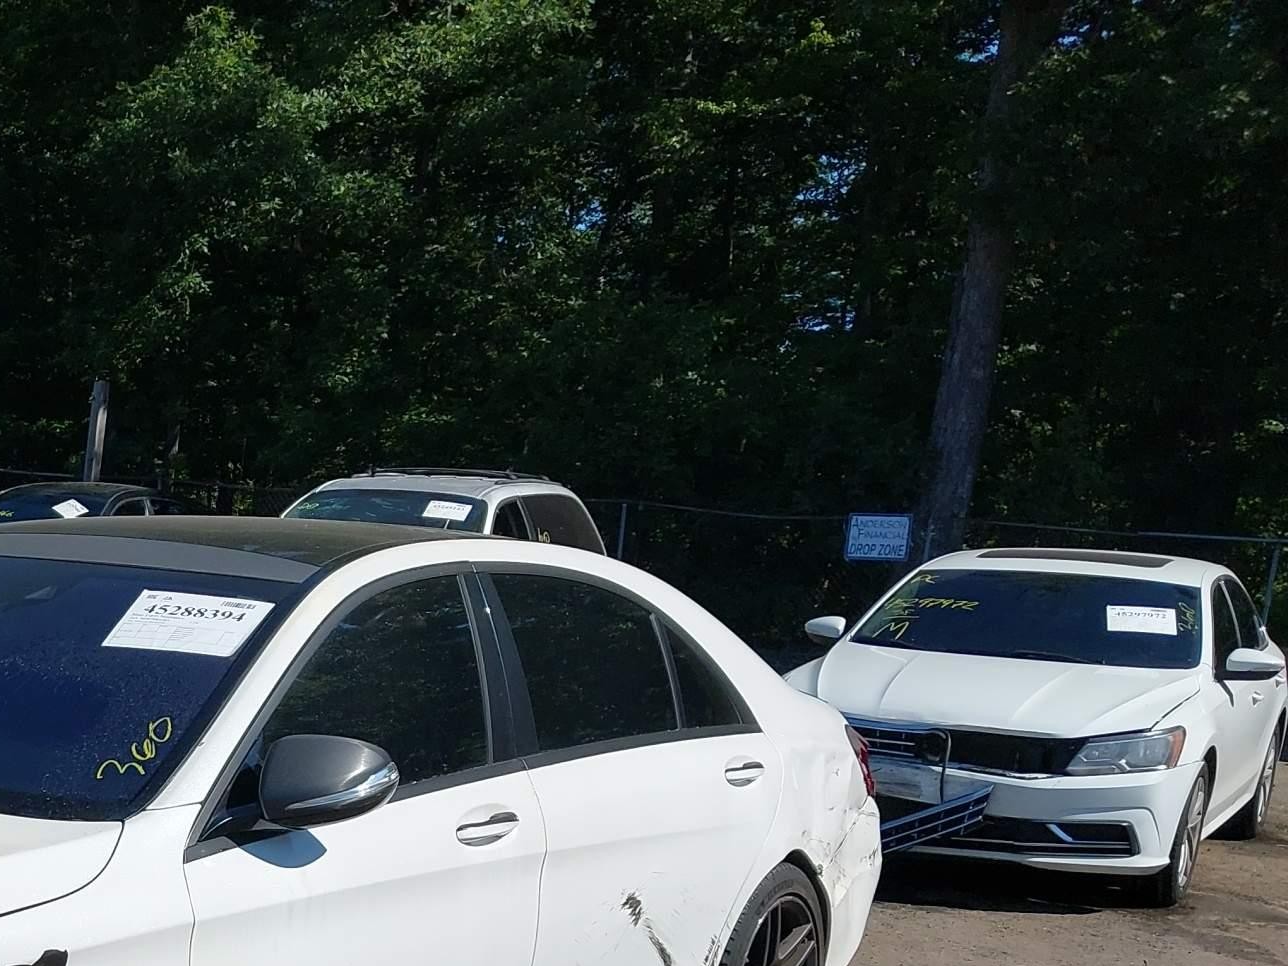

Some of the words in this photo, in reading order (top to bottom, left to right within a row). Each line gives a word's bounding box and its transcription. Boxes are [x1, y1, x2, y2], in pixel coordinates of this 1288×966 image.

[849, 543, 877, 555] DROP
[878, 543, 904, 556] ZONE
[143, 603, 247, 622] 45288394
[96, 716, 172, 779] 360
